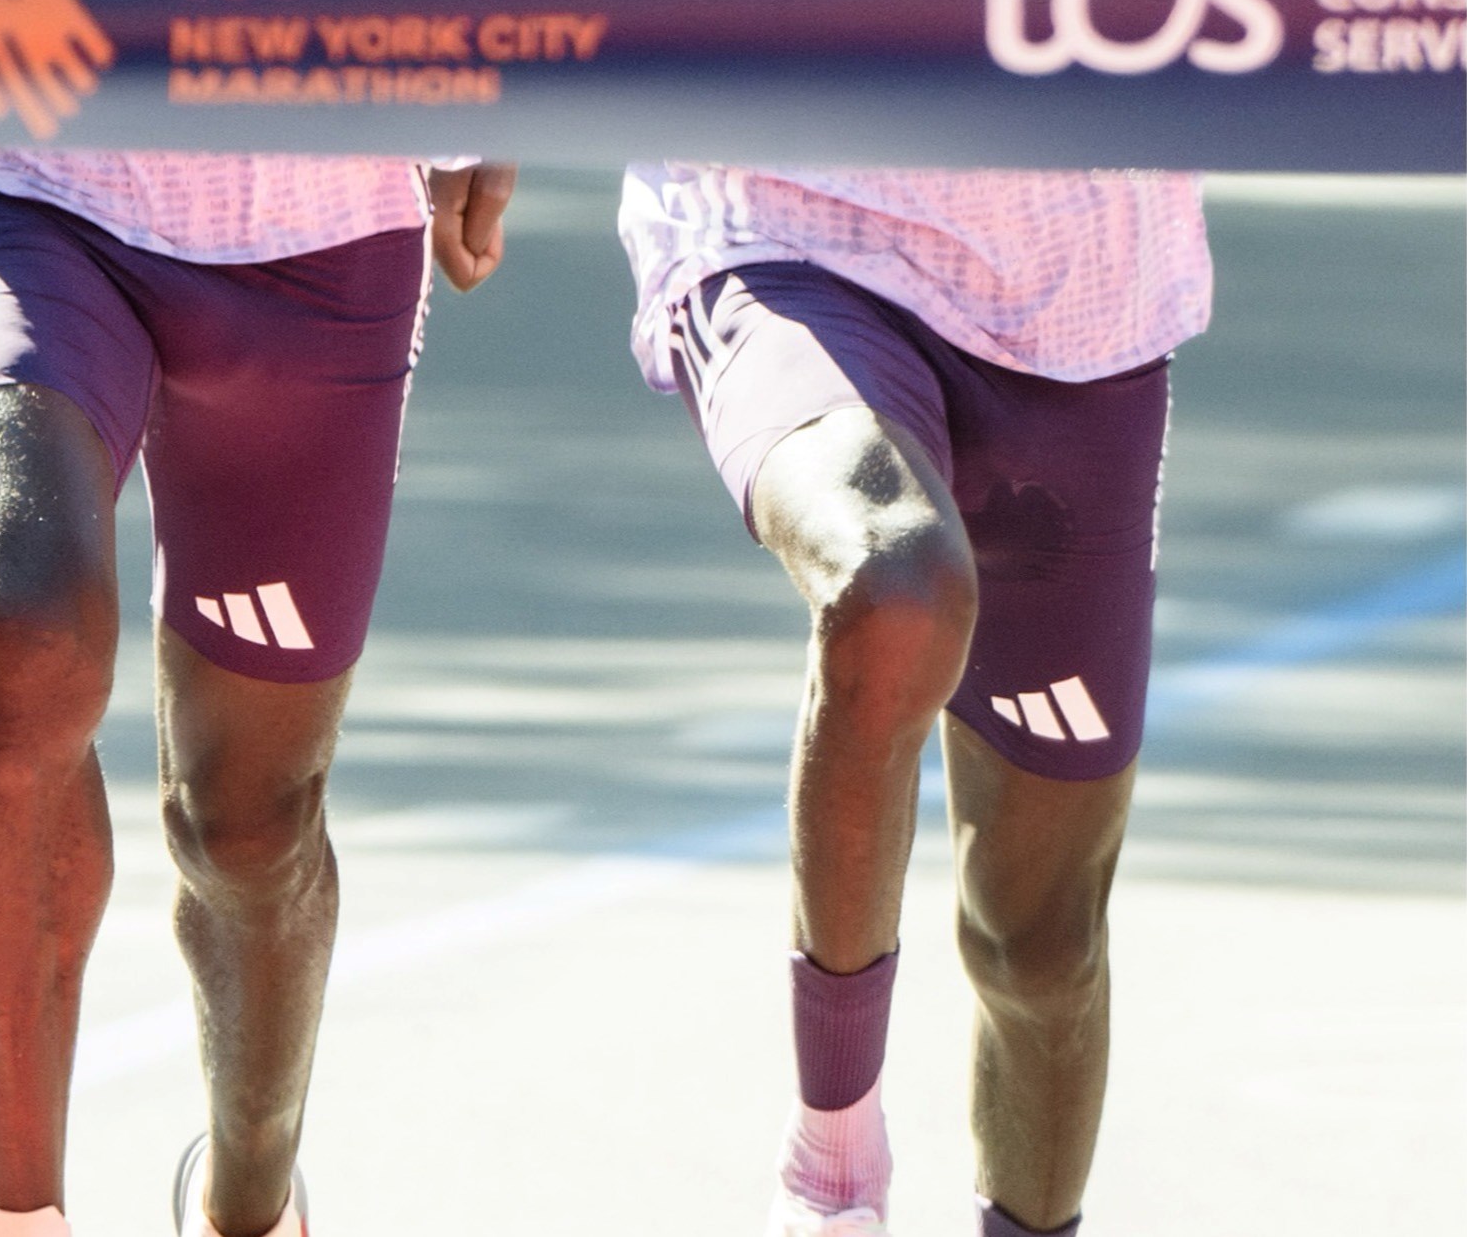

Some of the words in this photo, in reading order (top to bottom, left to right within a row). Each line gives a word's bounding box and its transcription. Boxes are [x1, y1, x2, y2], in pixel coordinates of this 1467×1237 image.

[170, 15, 307, 62] NEW
[313, 15, 471, 62] YORK
[475, 13, 609, 61] CITY
[169, 65, 501, 105] MARATHON
